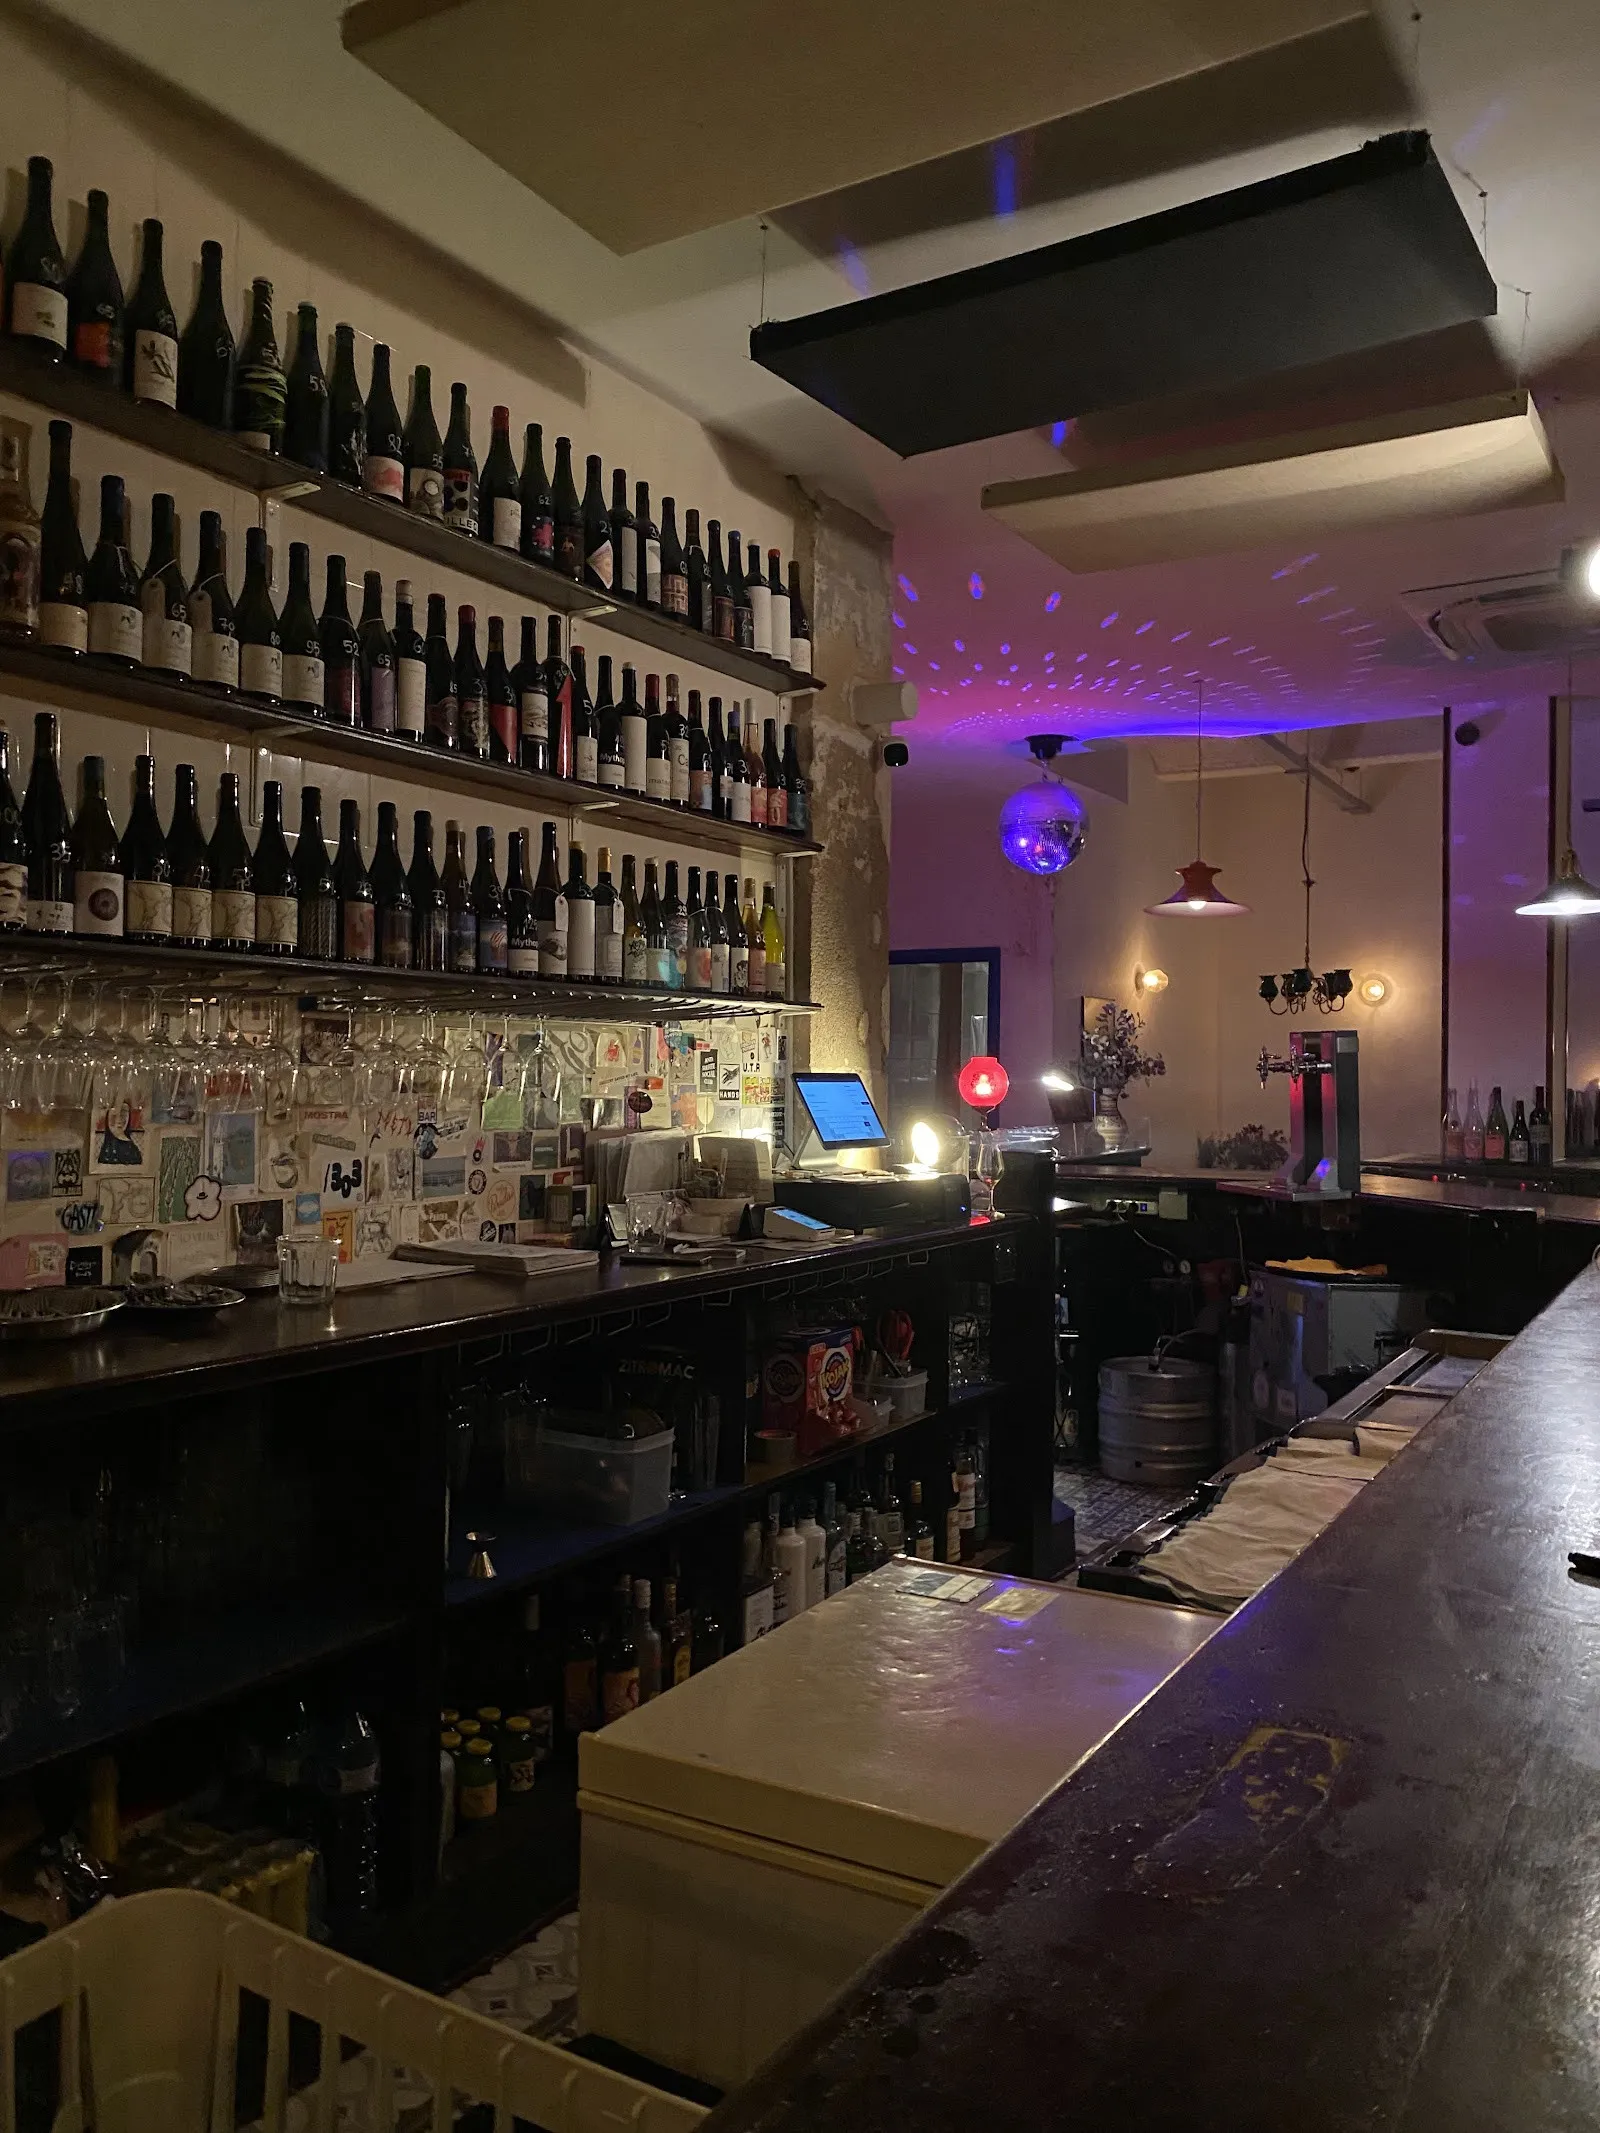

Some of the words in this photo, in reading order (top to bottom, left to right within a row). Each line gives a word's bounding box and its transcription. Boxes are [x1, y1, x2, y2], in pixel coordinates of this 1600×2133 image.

[719, 1091, 740, 1099] HANDS
[304, 1111, 349, 1120] MOSTRA
[418, 1111, 437, 1122] BAR
[821, 1354, 852, 1392] KOJAK
